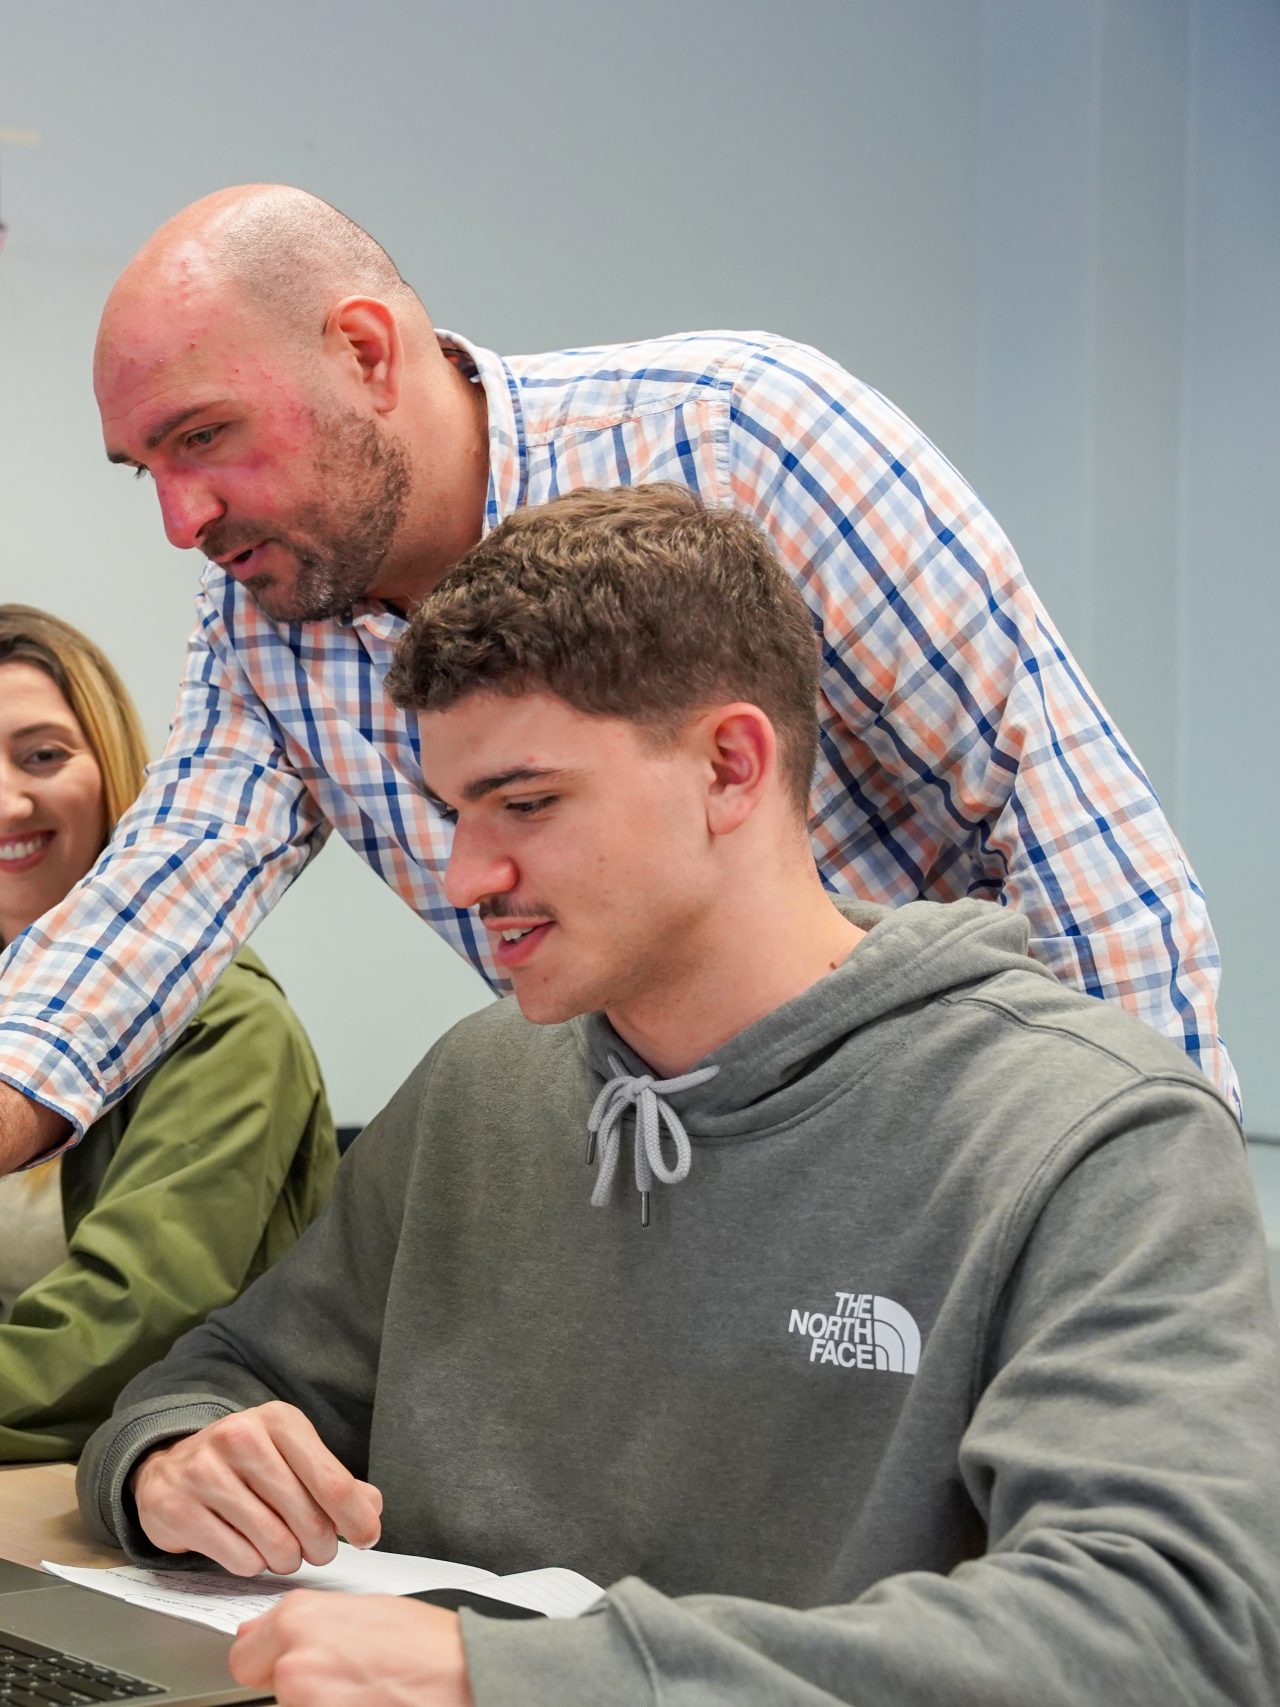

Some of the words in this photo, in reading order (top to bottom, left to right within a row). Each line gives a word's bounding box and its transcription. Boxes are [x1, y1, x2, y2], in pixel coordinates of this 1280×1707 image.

[835, 1291, 873, 1319] THE
[788, 1308, 873, 1345] NORTH
[809, 1338, 874, 1370] FACE
